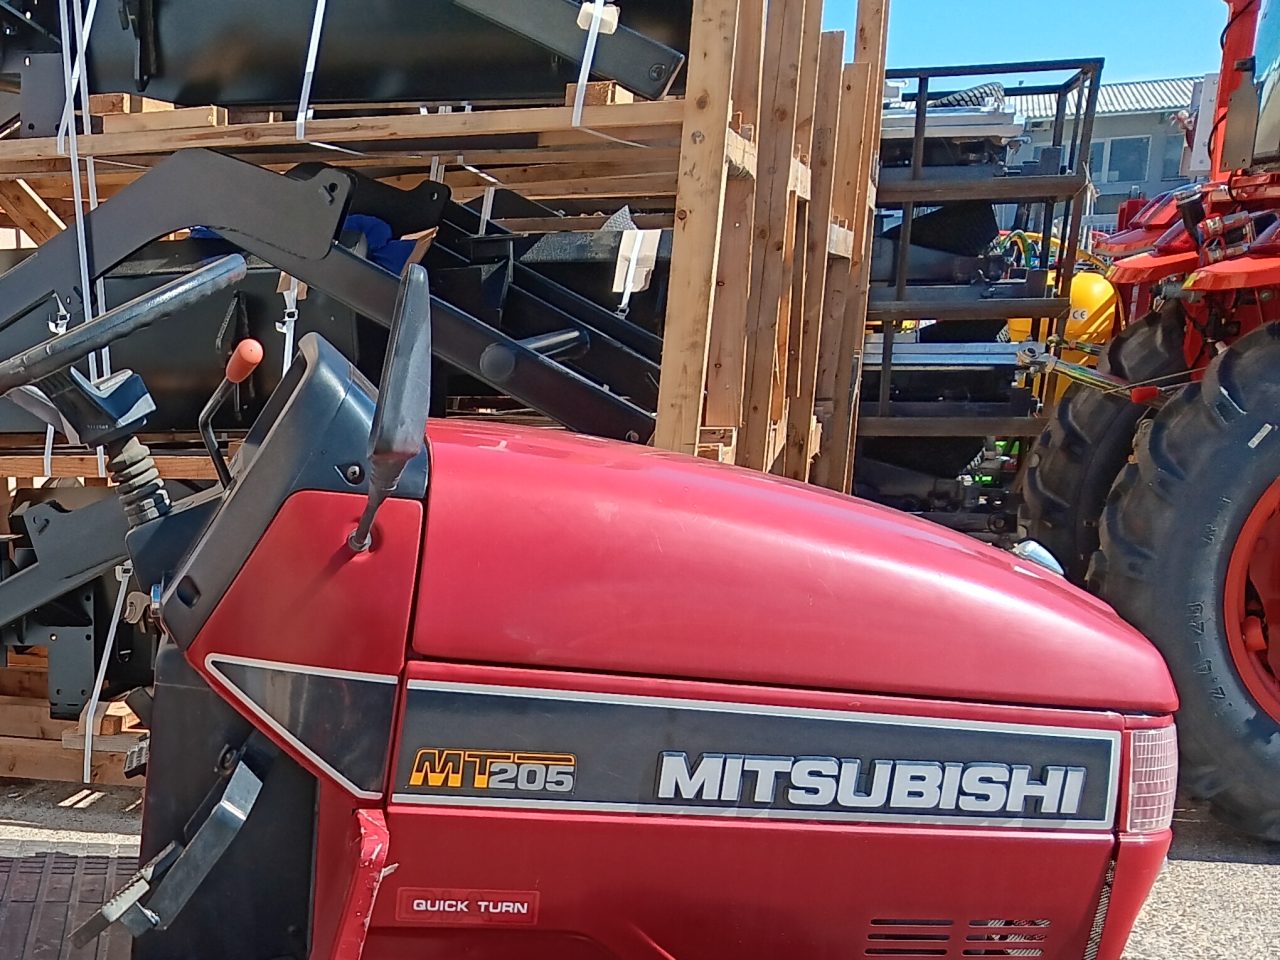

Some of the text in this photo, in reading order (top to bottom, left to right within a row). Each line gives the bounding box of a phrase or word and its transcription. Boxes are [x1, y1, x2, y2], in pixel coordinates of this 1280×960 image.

[408, 748, 577, 792] MT205
[657, 751, 1087, 815] MITSUBISHI
[413, 899, 529, 914] QUICK TURN
